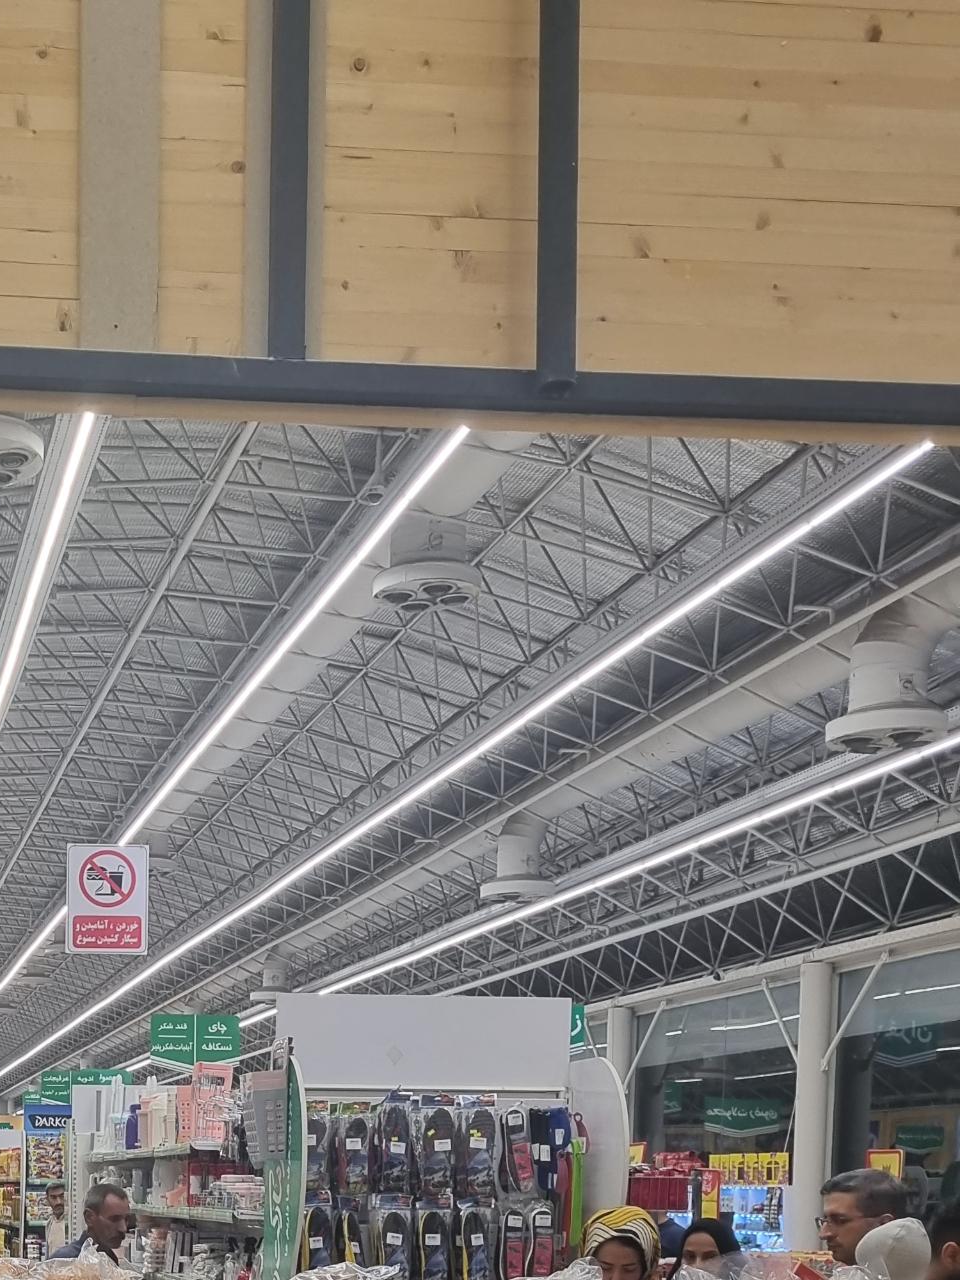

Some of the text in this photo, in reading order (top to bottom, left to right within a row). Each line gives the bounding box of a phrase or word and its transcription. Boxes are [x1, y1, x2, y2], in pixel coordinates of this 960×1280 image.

[75, 923, 79, 931] و
[81, 920, 108, 931] آشامیدن
[116, 921, 138, 932] خوردن
[77, 935, 96, 945] ممنوع
[97, 933, 119, 944] کشیدن
[158, 1022, 173, 1031] شکر
[208, 1021, 227, 1034] چای
[201, 1042, 232, 1051] نسکافه
